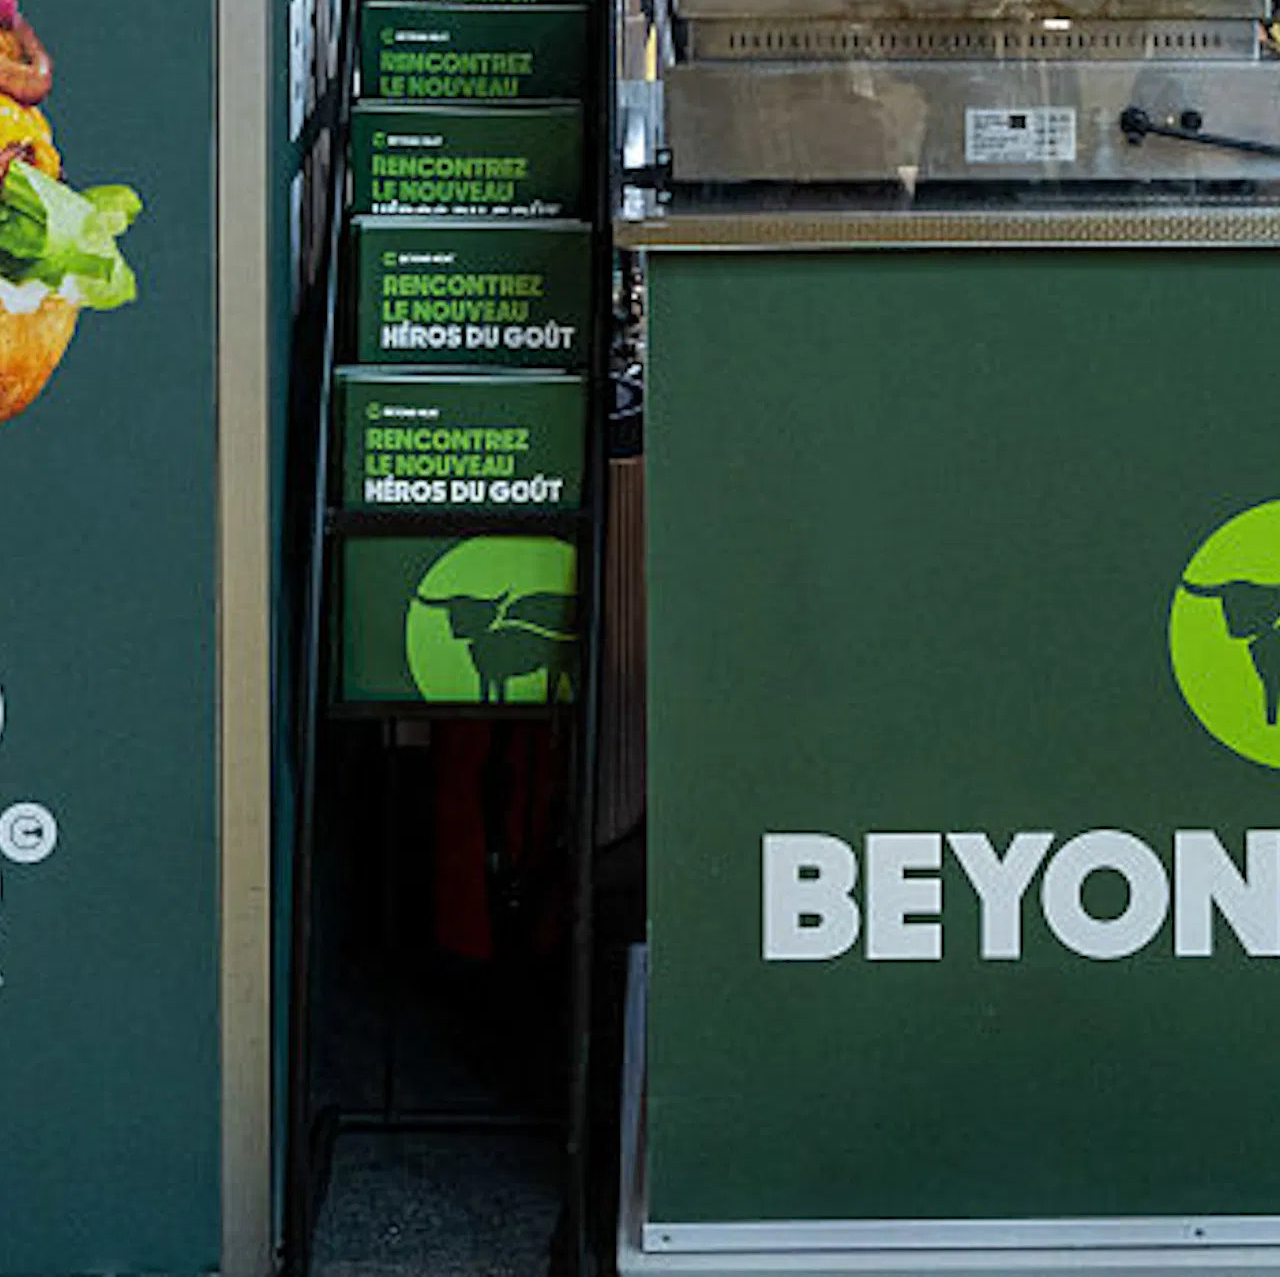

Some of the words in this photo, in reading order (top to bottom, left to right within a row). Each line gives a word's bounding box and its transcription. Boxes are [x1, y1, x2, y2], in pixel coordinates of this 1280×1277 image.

[382, 274, 545, 297] RENCONTREZ
[383, 300, 409, 323] LE
[410, 300, 530, 323] NOUVEAU
[380, 320, 462, 350] HÉROS
[465, 325, 500, 350] DU
[502, 320, 576, 350] GOÛT
[365, 428, 530, 451] RENCONTREZ
[366, 454, 394, 477] LE
[394, 454, 516, 477] NOUVEAU
[364, 475, 448, 504] HÉROS
[450, 479, 487, 504] DU
[488, 474, 564, 504] GOÛT
